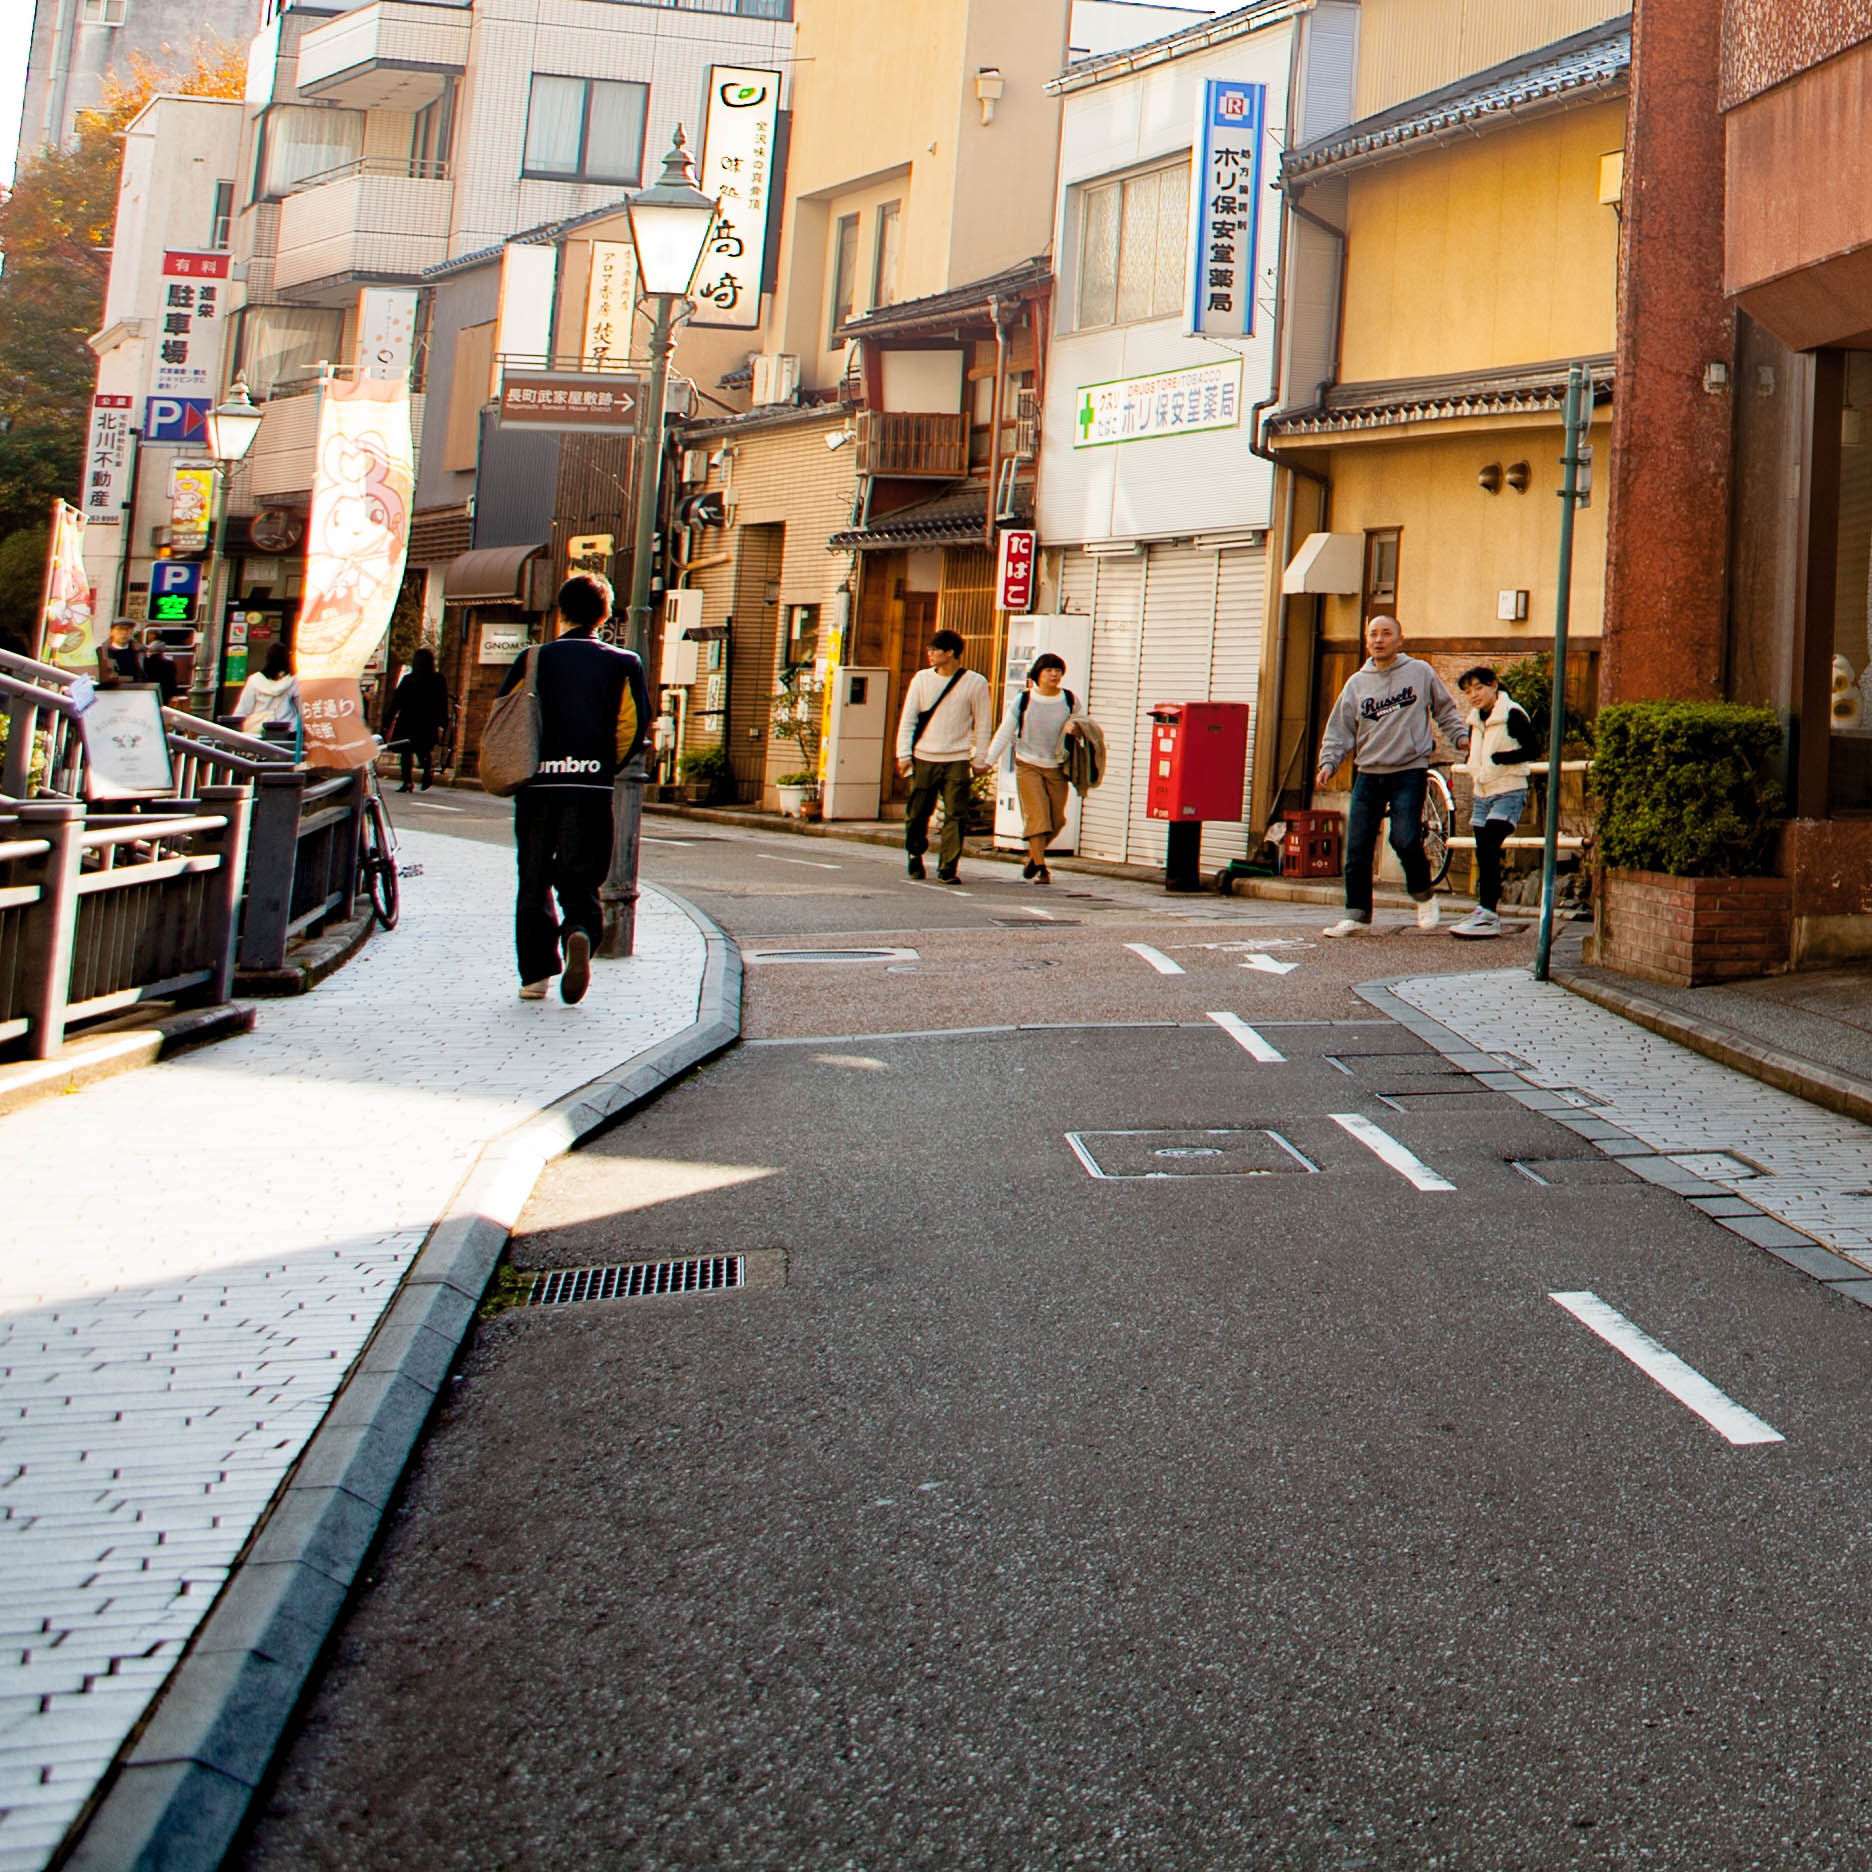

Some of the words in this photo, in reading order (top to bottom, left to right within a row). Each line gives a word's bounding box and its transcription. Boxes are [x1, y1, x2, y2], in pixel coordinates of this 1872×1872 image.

[1208, 147, 1240, 313] ホリ保安堂薬局
[175, 258, 217, 274] 有料
[159, 282, 196, 365] 駐車場
[507, 388, 613, 407] 長町武家屋敷跡
[1099, 391, 1121, 411] クスリ
[1122, 382, 1235, 433] ホリ保安堂薬局
[148, 399, 183, 439] P
[90, 413, 117, 508] 北川不動産
[163, 566, 190, 591] P
[1006, 535, 1030, 605] たばこ
[157, 594, 190, 619] 空
[1361, 686, 1416, 716] Russell
